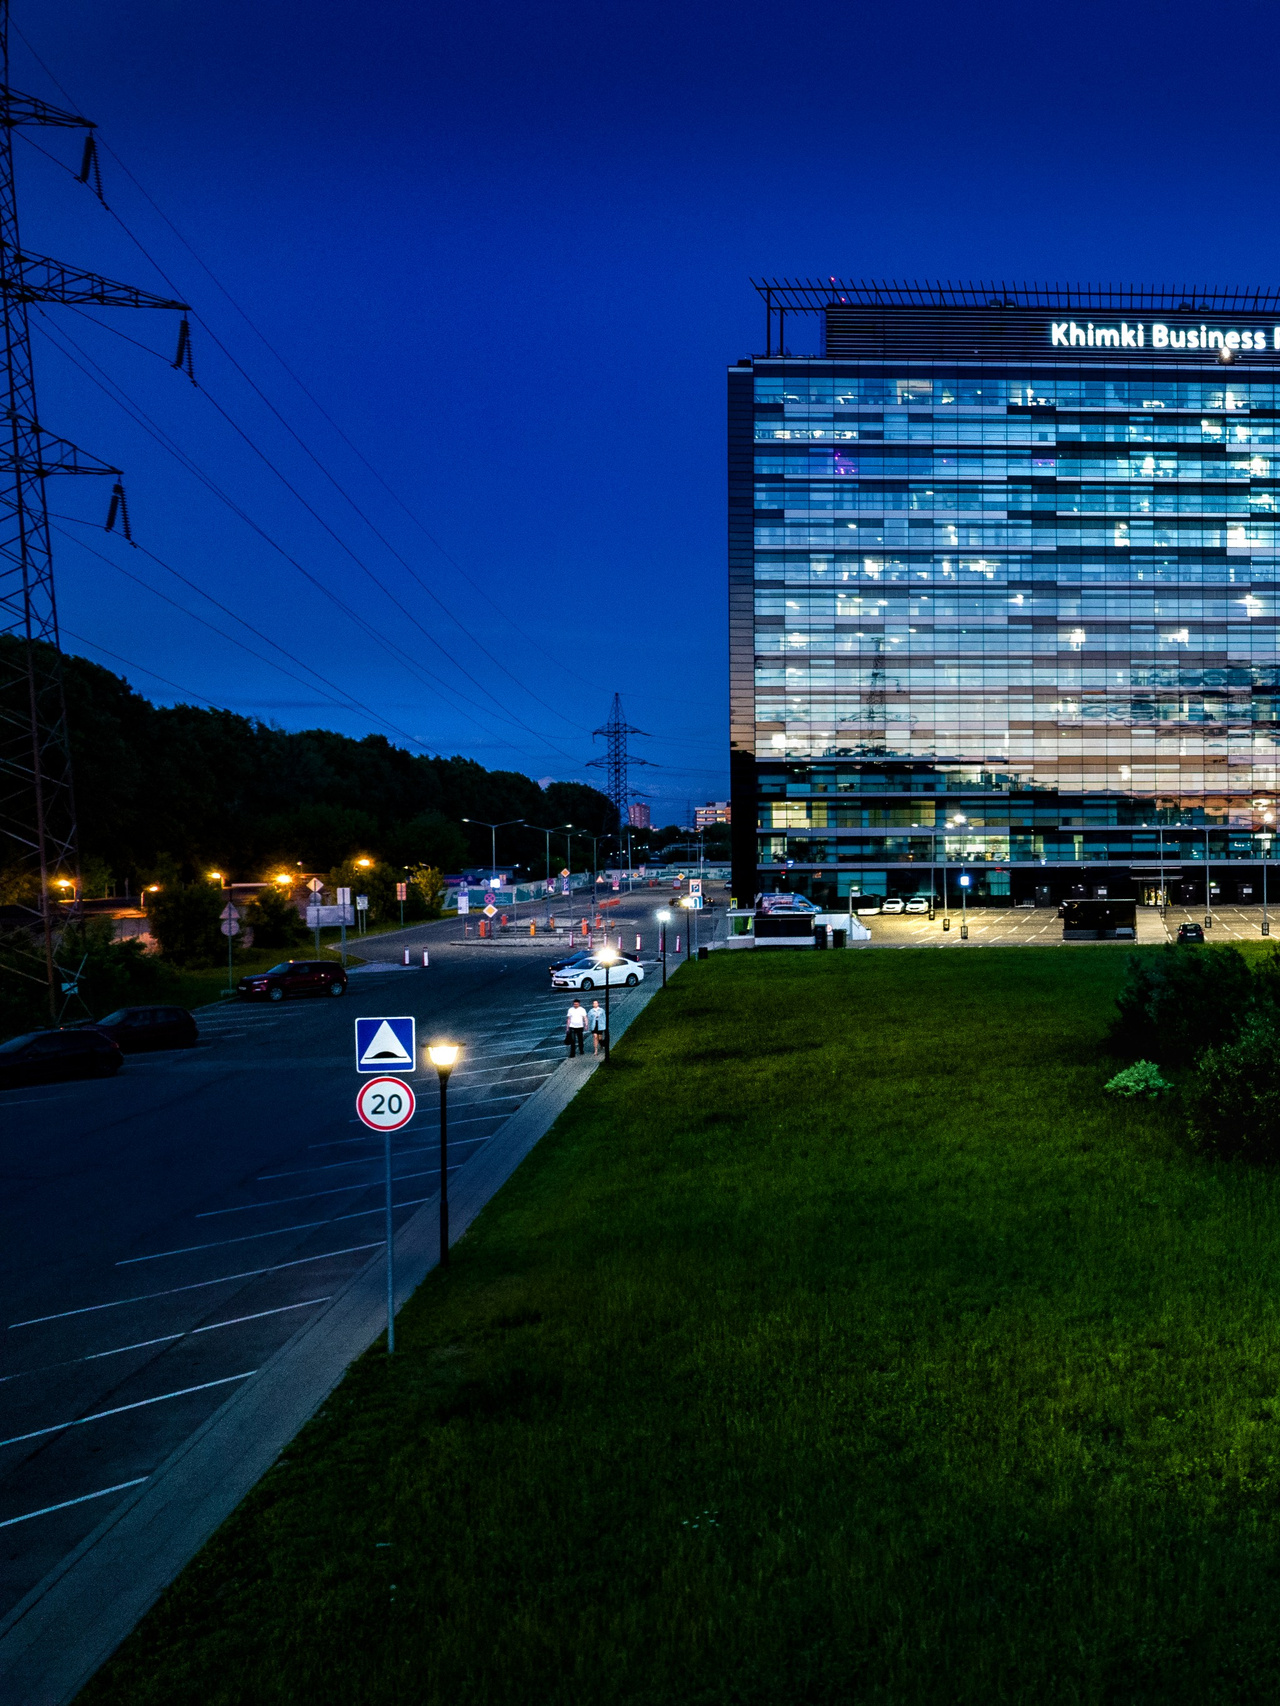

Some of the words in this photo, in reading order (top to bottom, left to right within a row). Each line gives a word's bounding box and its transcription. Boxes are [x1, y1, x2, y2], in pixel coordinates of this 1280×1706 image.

[1051, 321, 1145, 349] Khimki
[1152, 324, 1267, 351] Business
[371, 1094, 402, 1115] 20
